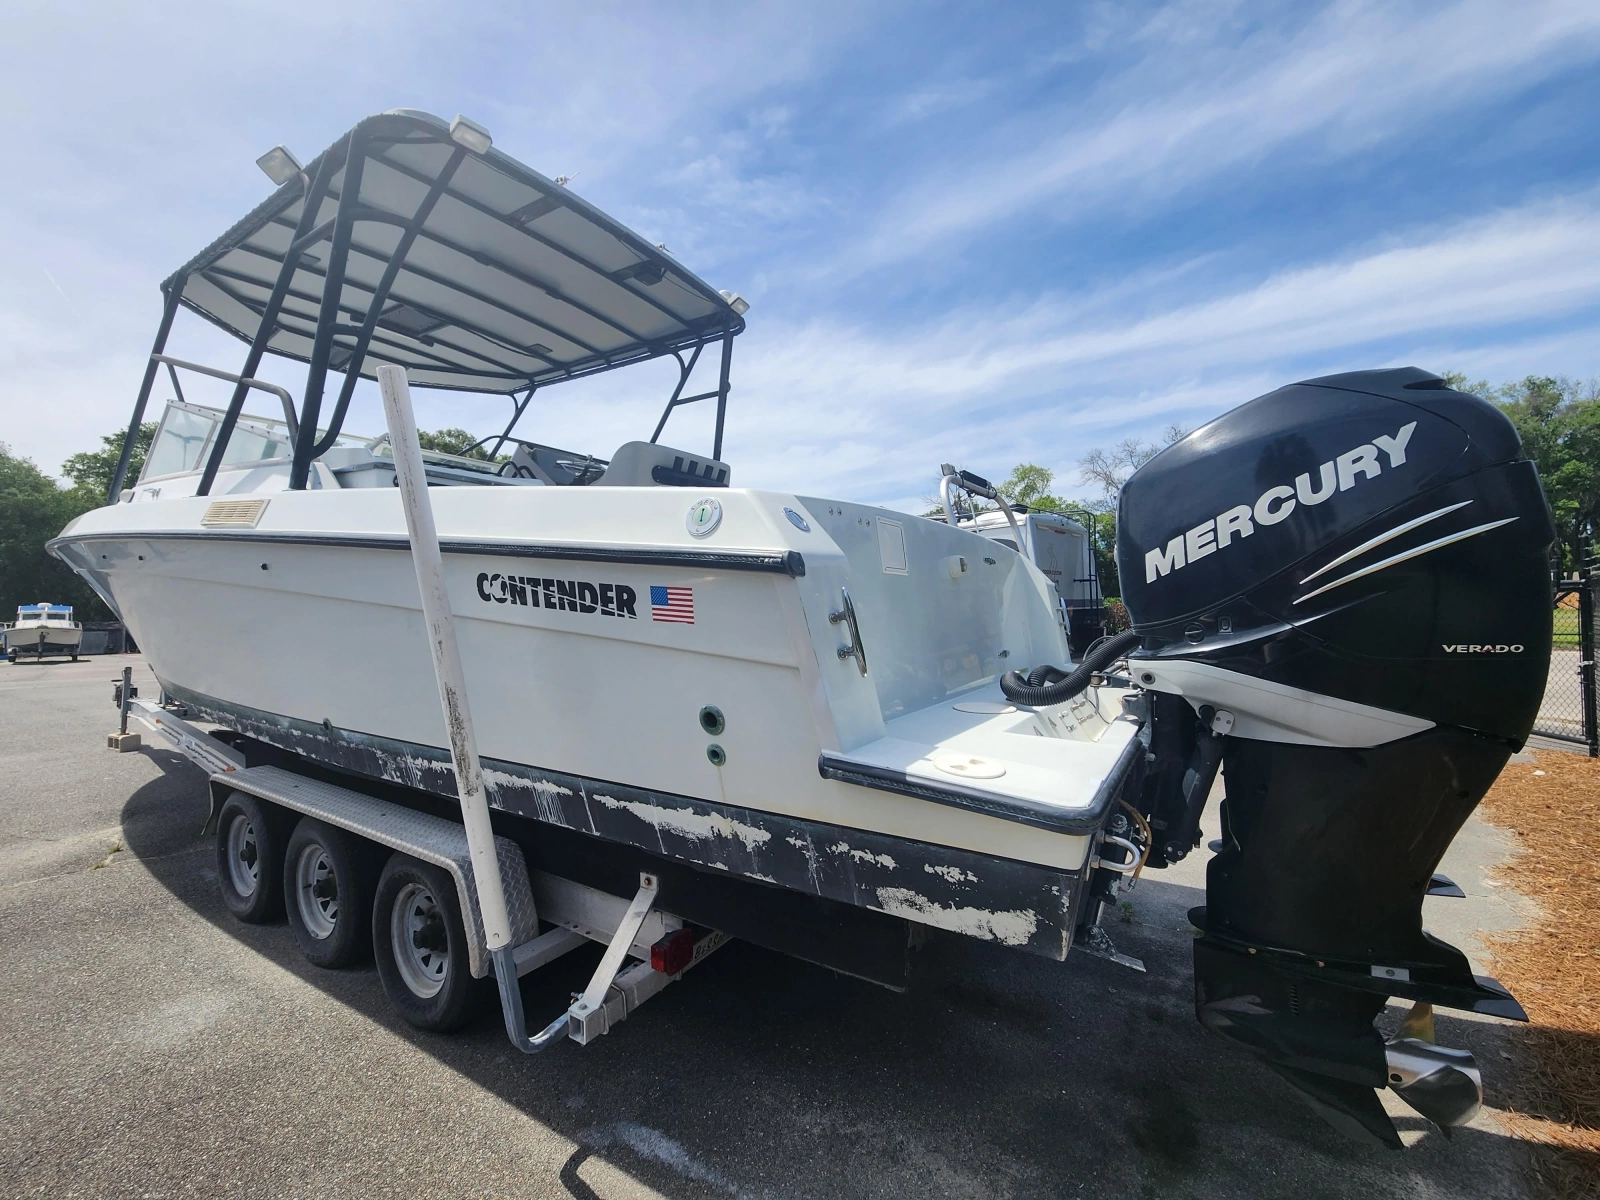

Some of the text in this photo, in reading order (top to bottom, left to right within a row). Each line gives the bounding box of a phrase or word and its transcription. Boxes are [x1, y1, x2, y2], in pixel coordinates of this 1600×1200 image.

[1145, 421, 1417, 584] MERCURY
[477, 572, 638, 619] CONTENDER
[1442, 644, 1525, 653] VERADO
